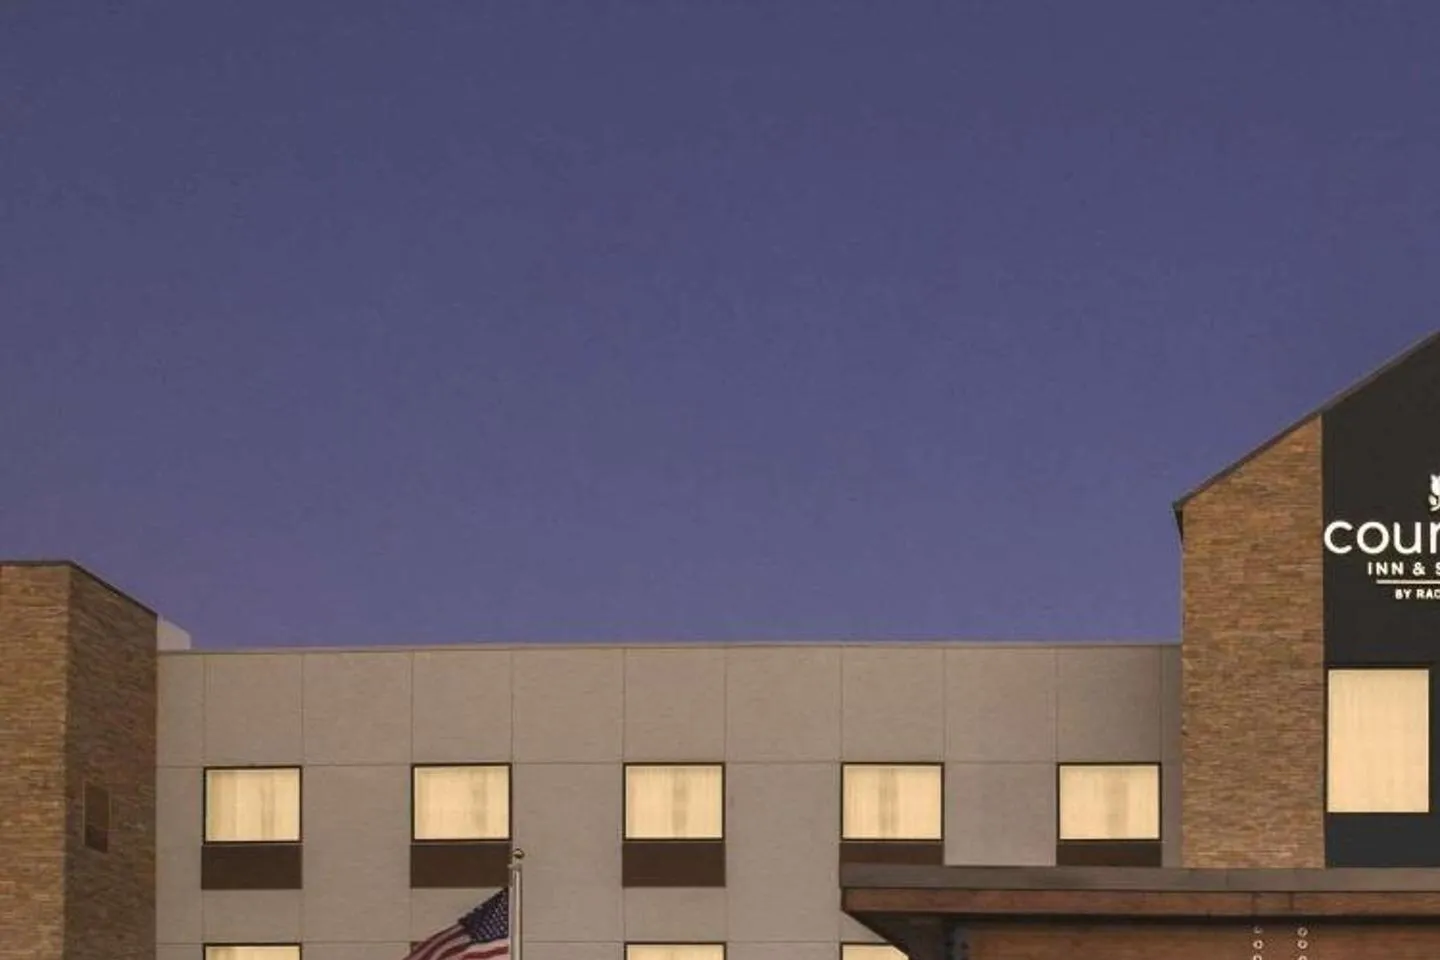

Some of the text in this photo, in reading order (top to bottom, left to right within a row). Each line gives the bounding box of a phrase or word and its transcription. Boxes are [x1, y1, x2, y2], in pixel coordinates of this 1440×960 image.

[1367, 561, 1404, 576] INN
[1412, 561, 1426, 576] &
[1395, 588, 1412, 600] BY
